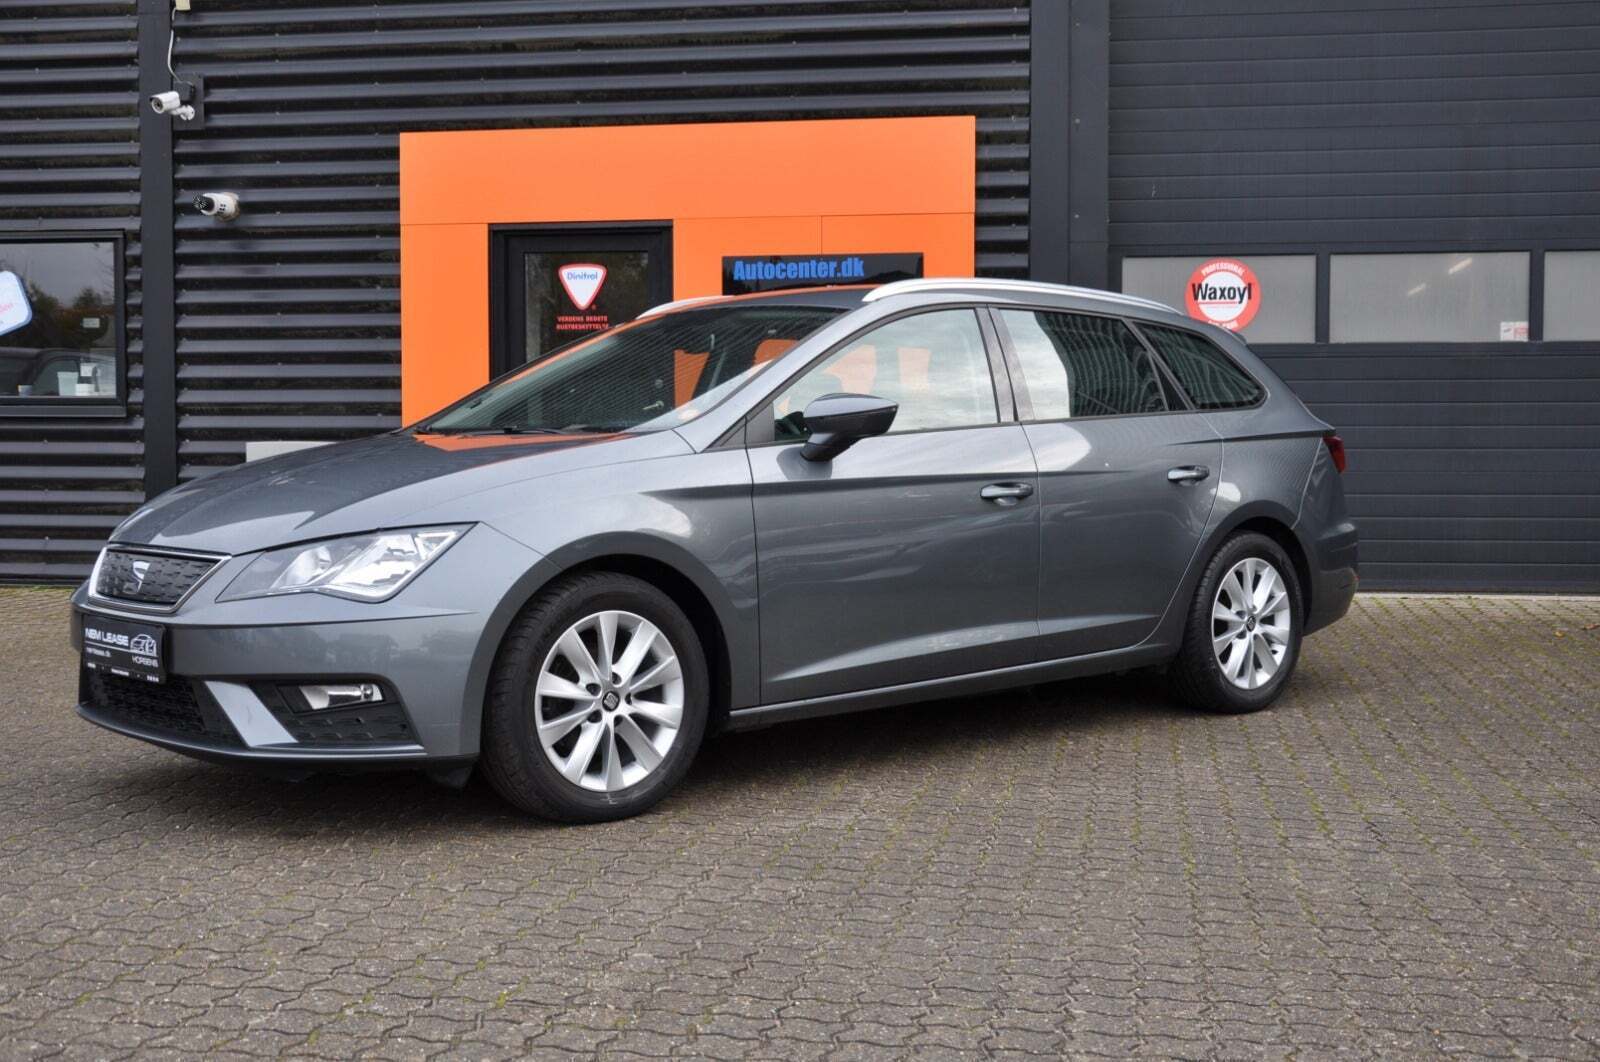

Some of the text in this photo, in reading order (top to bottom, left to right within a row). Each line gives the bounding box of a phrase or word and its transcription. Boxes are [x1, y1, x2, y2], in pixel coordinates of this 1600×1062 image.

[567, 271, 598, 281] Dinitrol
[733, 257, 865, 281] Autocenter.dk
[1192, 282, 1252, 305] Waxoyl
[102, 631, 129, 647] LEASE
